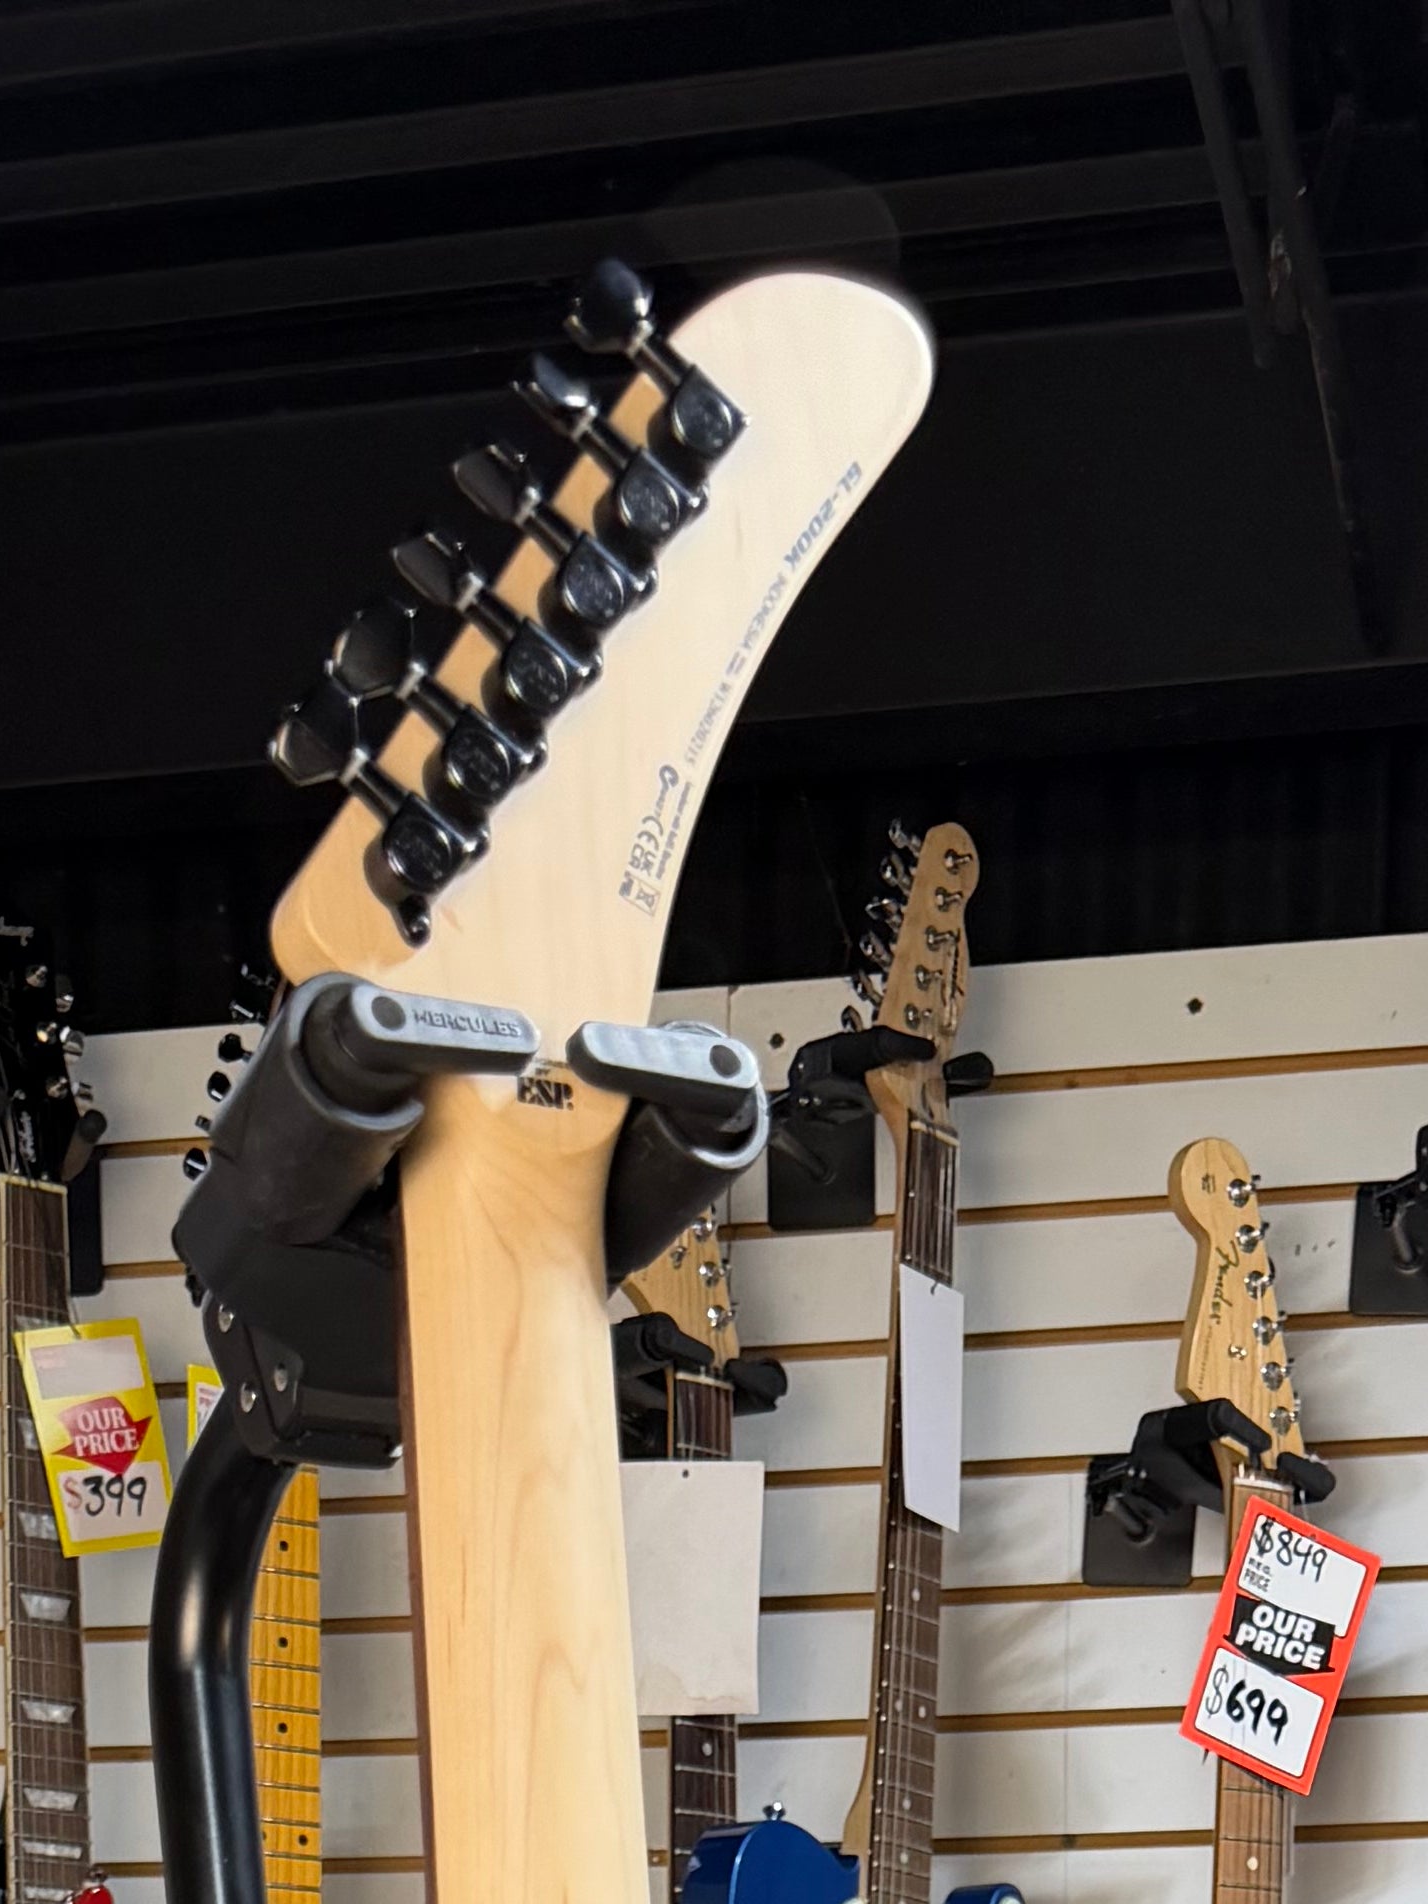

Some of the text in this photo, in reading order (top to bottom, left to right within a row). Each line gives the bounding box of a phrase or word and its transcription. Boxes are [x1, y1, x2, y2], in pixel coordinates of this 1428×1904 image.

[412, 1008, 523, 1039] HERCULES
[1209, 1237, 1241, 1326] Fender
[76, 1406, 128, 1432] OUR
[74, 1428, 139, 1457] PRICE
[63, 1473, 147, 1517] $399
[1254, 1517, 1328, 1584] $849
[1251, 1603, 1317, 1643] OUR
[1234, 1622, 1326, 1671] PRICE
[1205, 1663, 1289, 1747] $699
